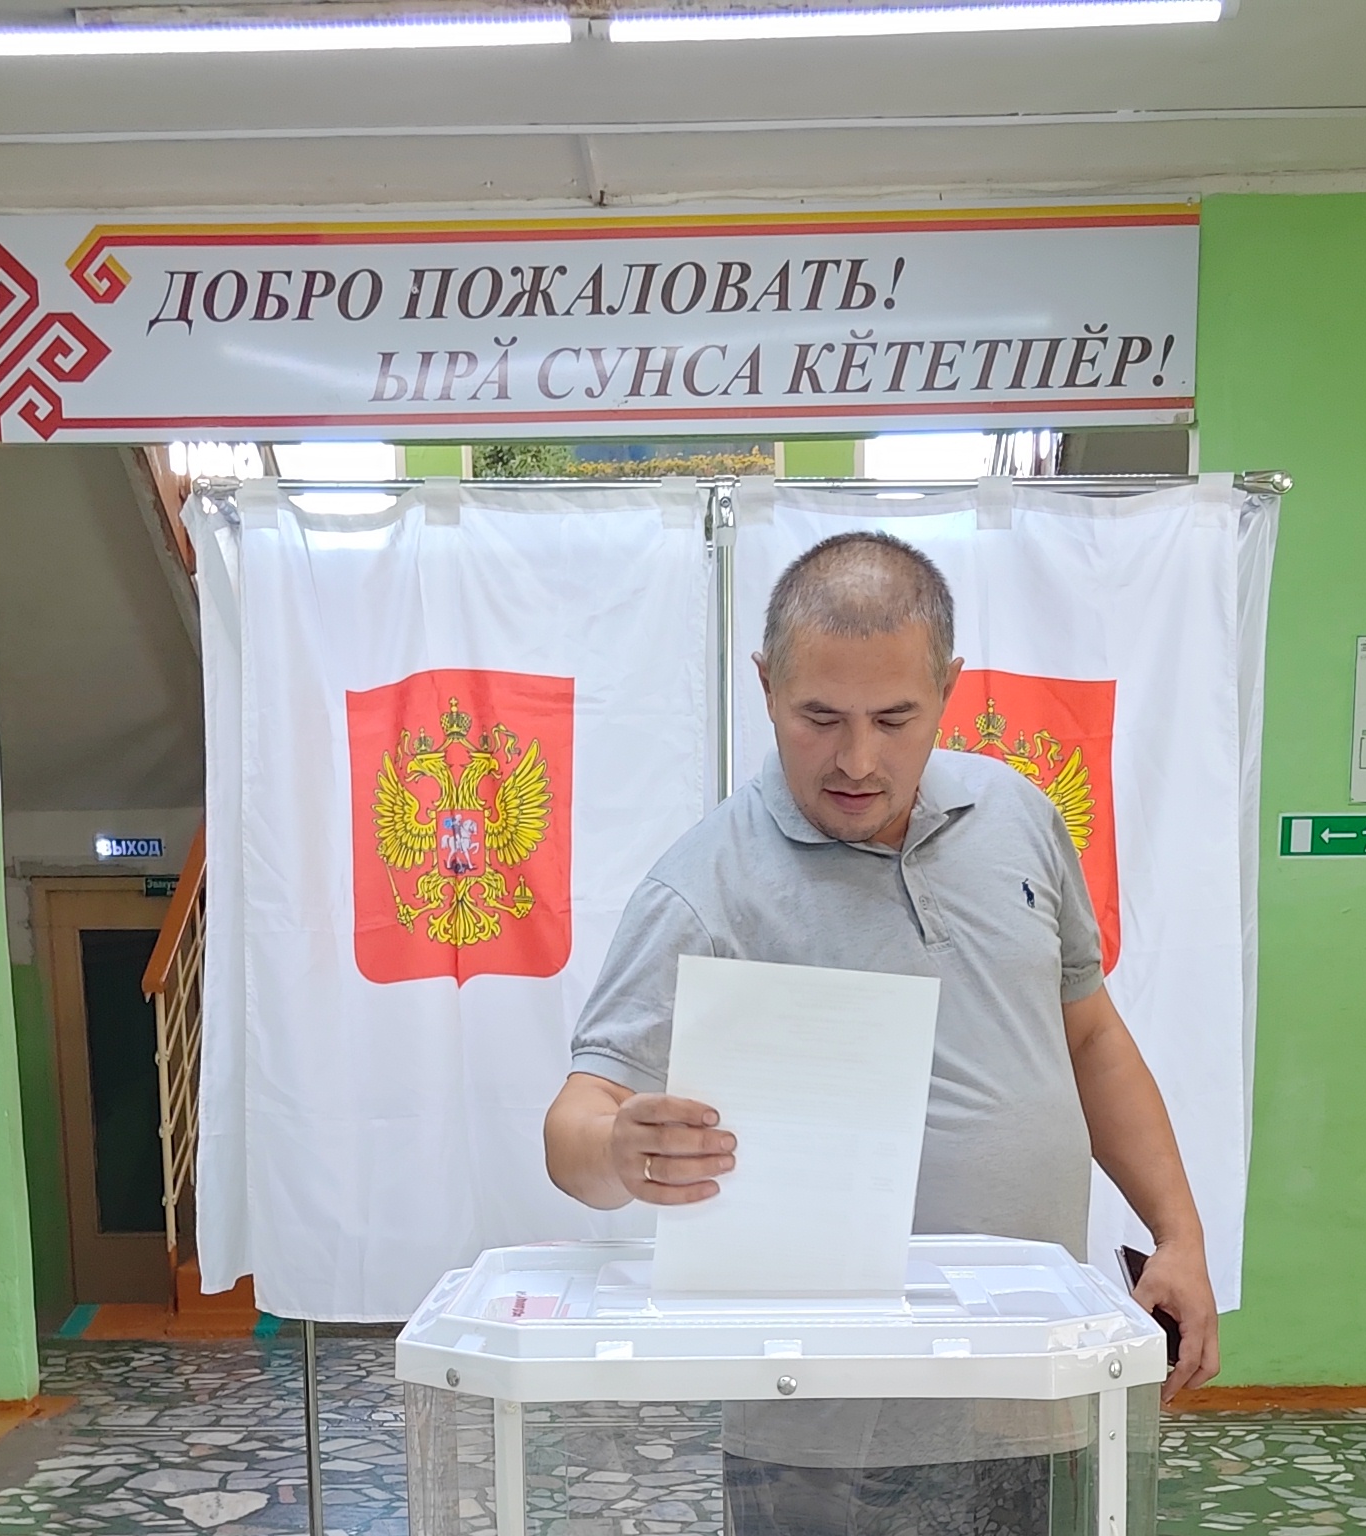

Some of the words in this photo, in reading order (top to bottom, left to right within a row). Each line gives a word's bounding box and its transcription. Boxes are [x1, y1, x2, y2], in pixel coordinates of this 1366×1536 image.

[146, 267, 383, 336] ДОБРО
[400, 256, 906, 319] ПОЖАЛОВАТЬ!
[368, 336, 519, 403] ЫРӐ
[537, 342, 763, 400] СУНСА
[101, 840, 161, 857] ВЫХОД
